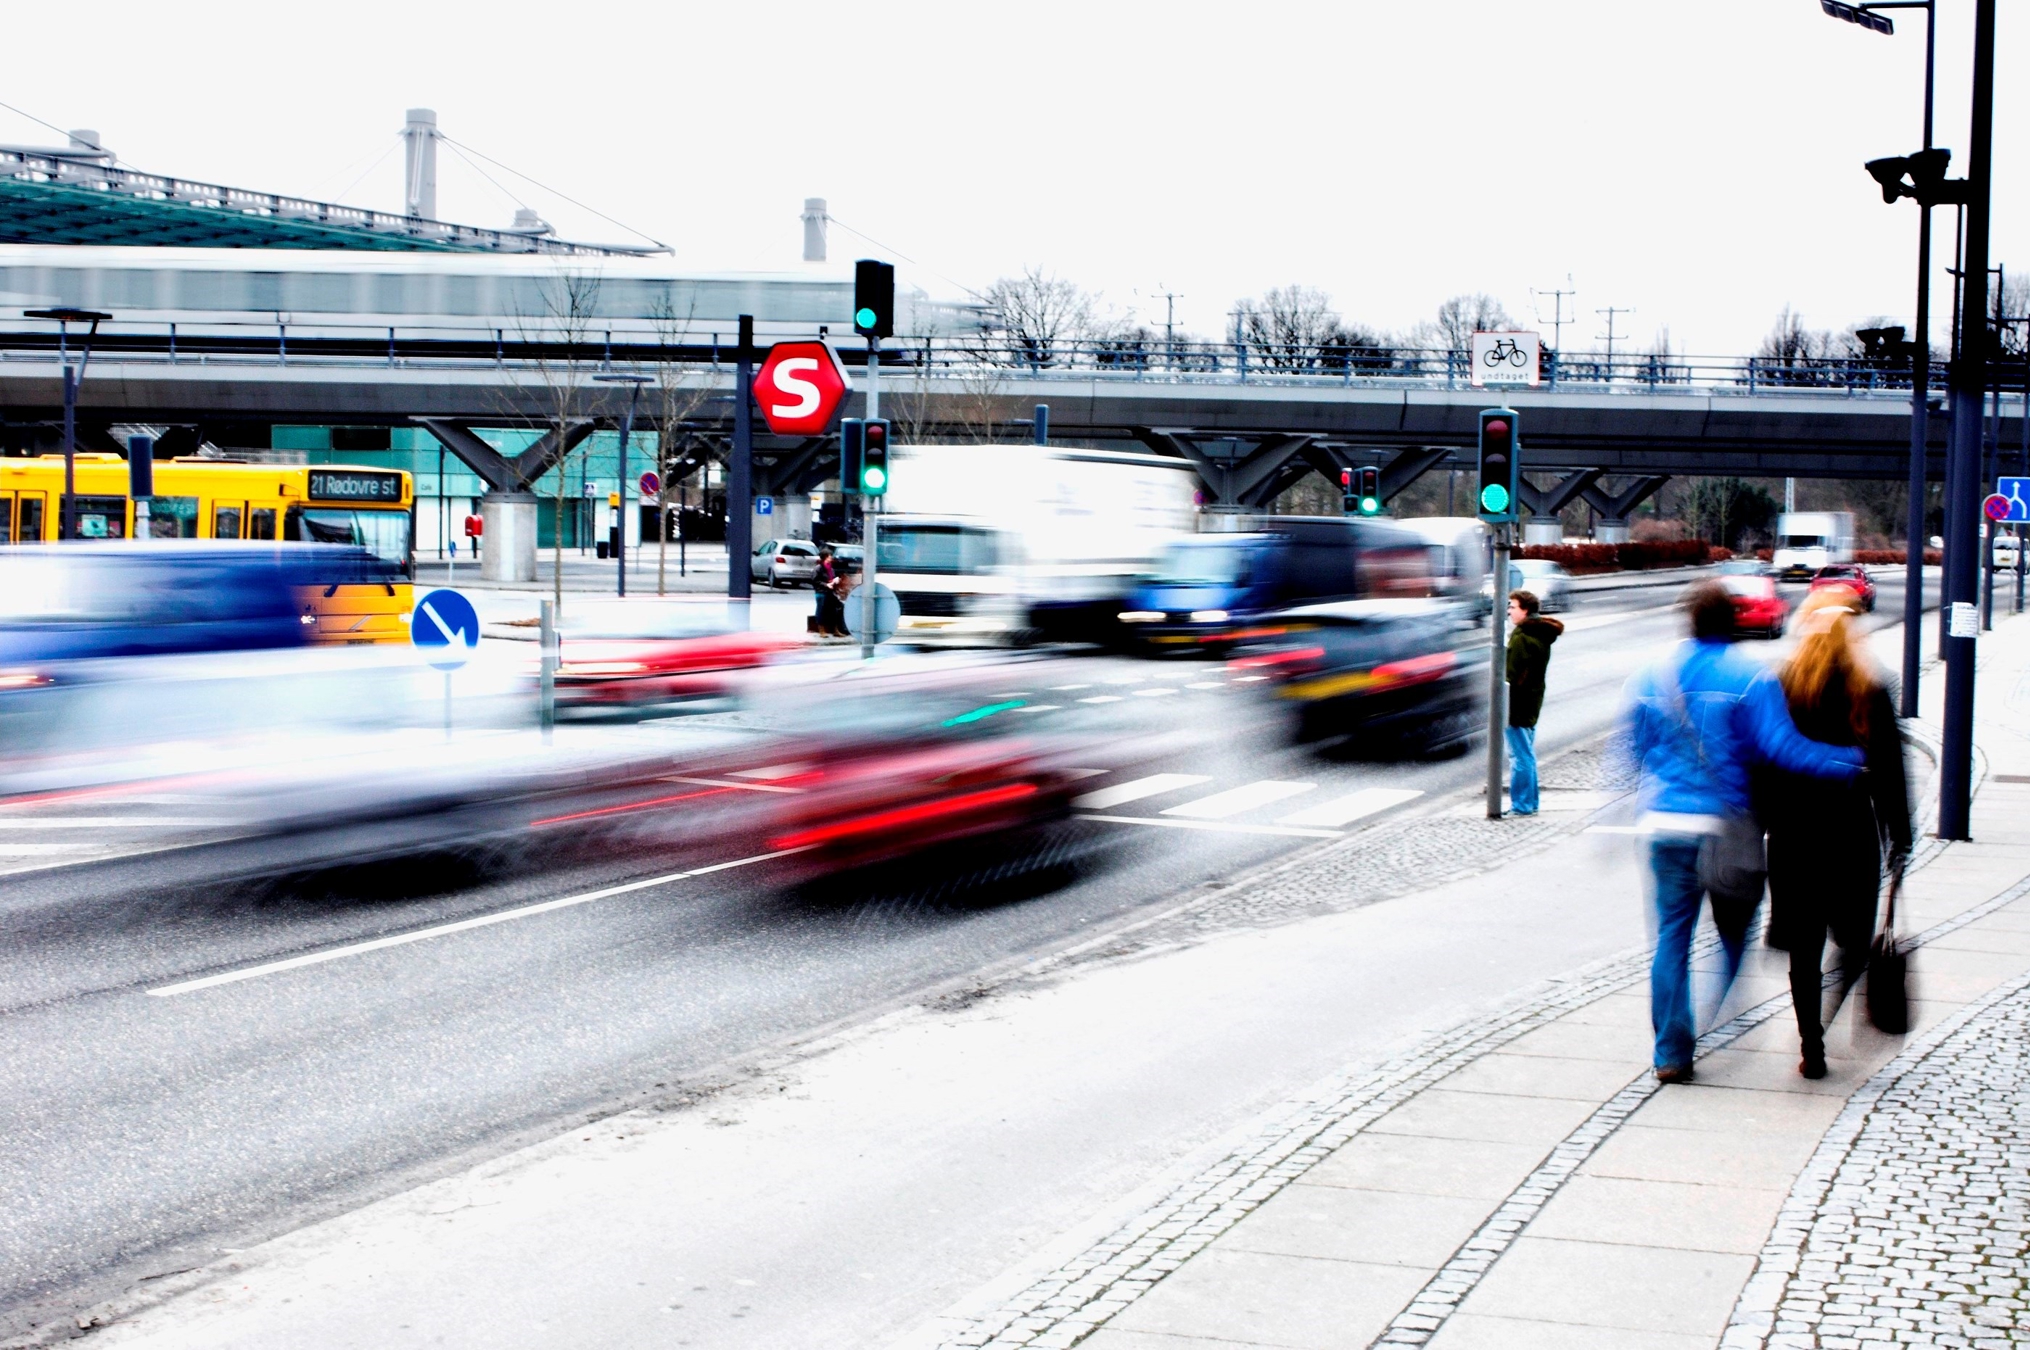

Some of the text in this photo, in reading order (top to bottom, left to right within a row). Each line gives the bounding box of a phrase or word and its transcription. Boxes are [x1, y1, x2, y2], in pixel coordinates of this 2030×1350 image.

[1480, 372, 1529, 381] undtaget
[772, 357, 821, 418] S
[311, 475, 323, 495] 21
[326, 475, 379, 495] Rødovre
[760, 499, 770, 513] P
